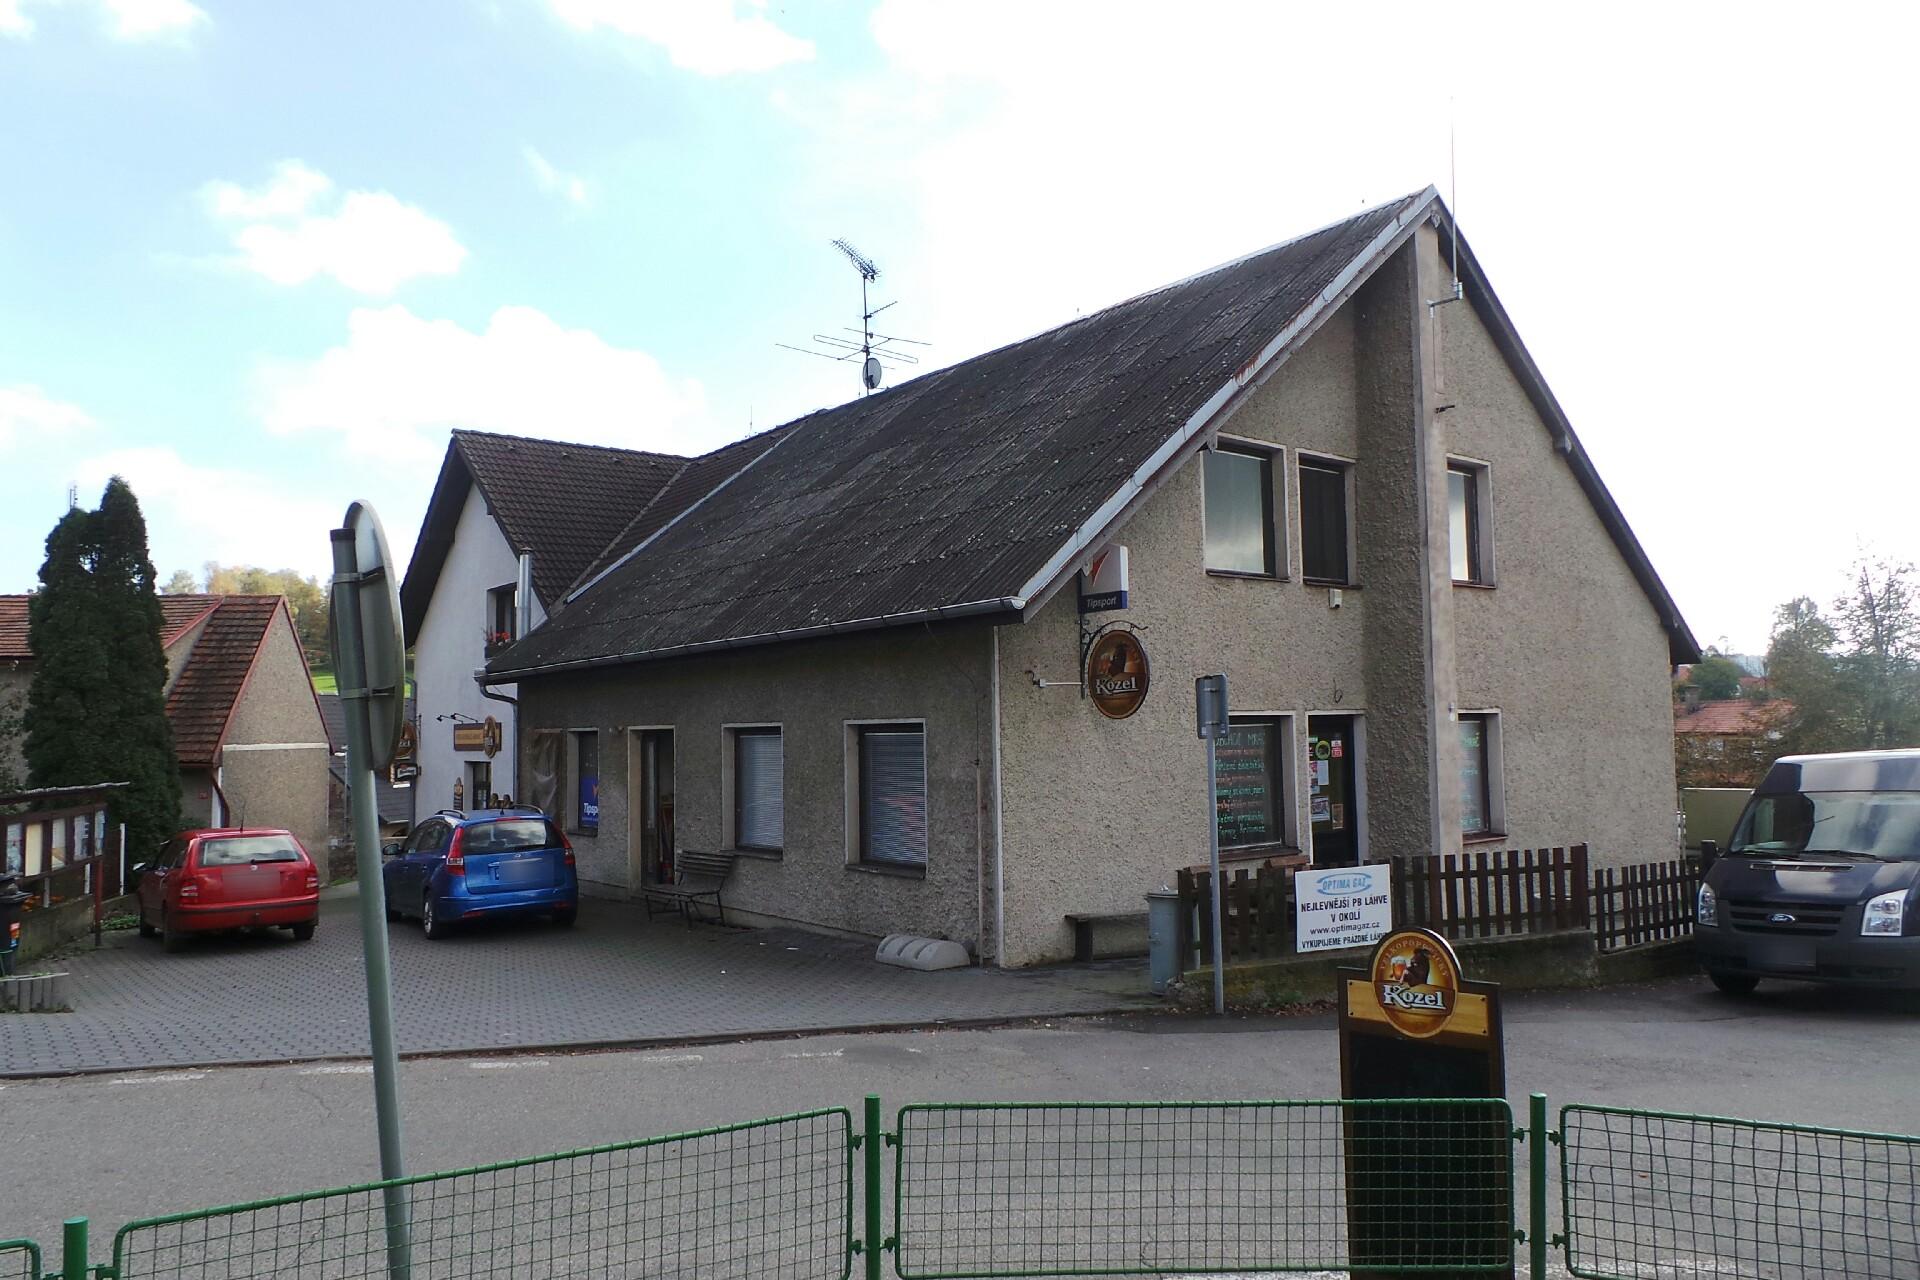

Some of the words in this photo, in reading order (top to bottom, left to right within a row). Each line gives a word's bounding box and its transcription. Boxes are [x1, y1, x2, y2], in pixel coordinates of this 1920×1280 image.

[1086, 596, 1117, 609] Tipsport
[1095, 677, 1139, 695] Kozel
[1322, 879, 1351, 891] OPTIMA
[1352, 877, 1367, 888] GAZ
[1301, 897, 1350, 912] NEJLEVNĚJŠÍ
[1352, 897, 1362, 908] PB
[1330, 913, 1336, 922] V
[1338, 908, 1361, 922] OKOLÍ
[1309, 921, 1380, 935] www.optimagaz.cz
[1301, 937, 1341, 949] VYKUPUJEME
[1383, 984, 1446, 1010] Kozel
